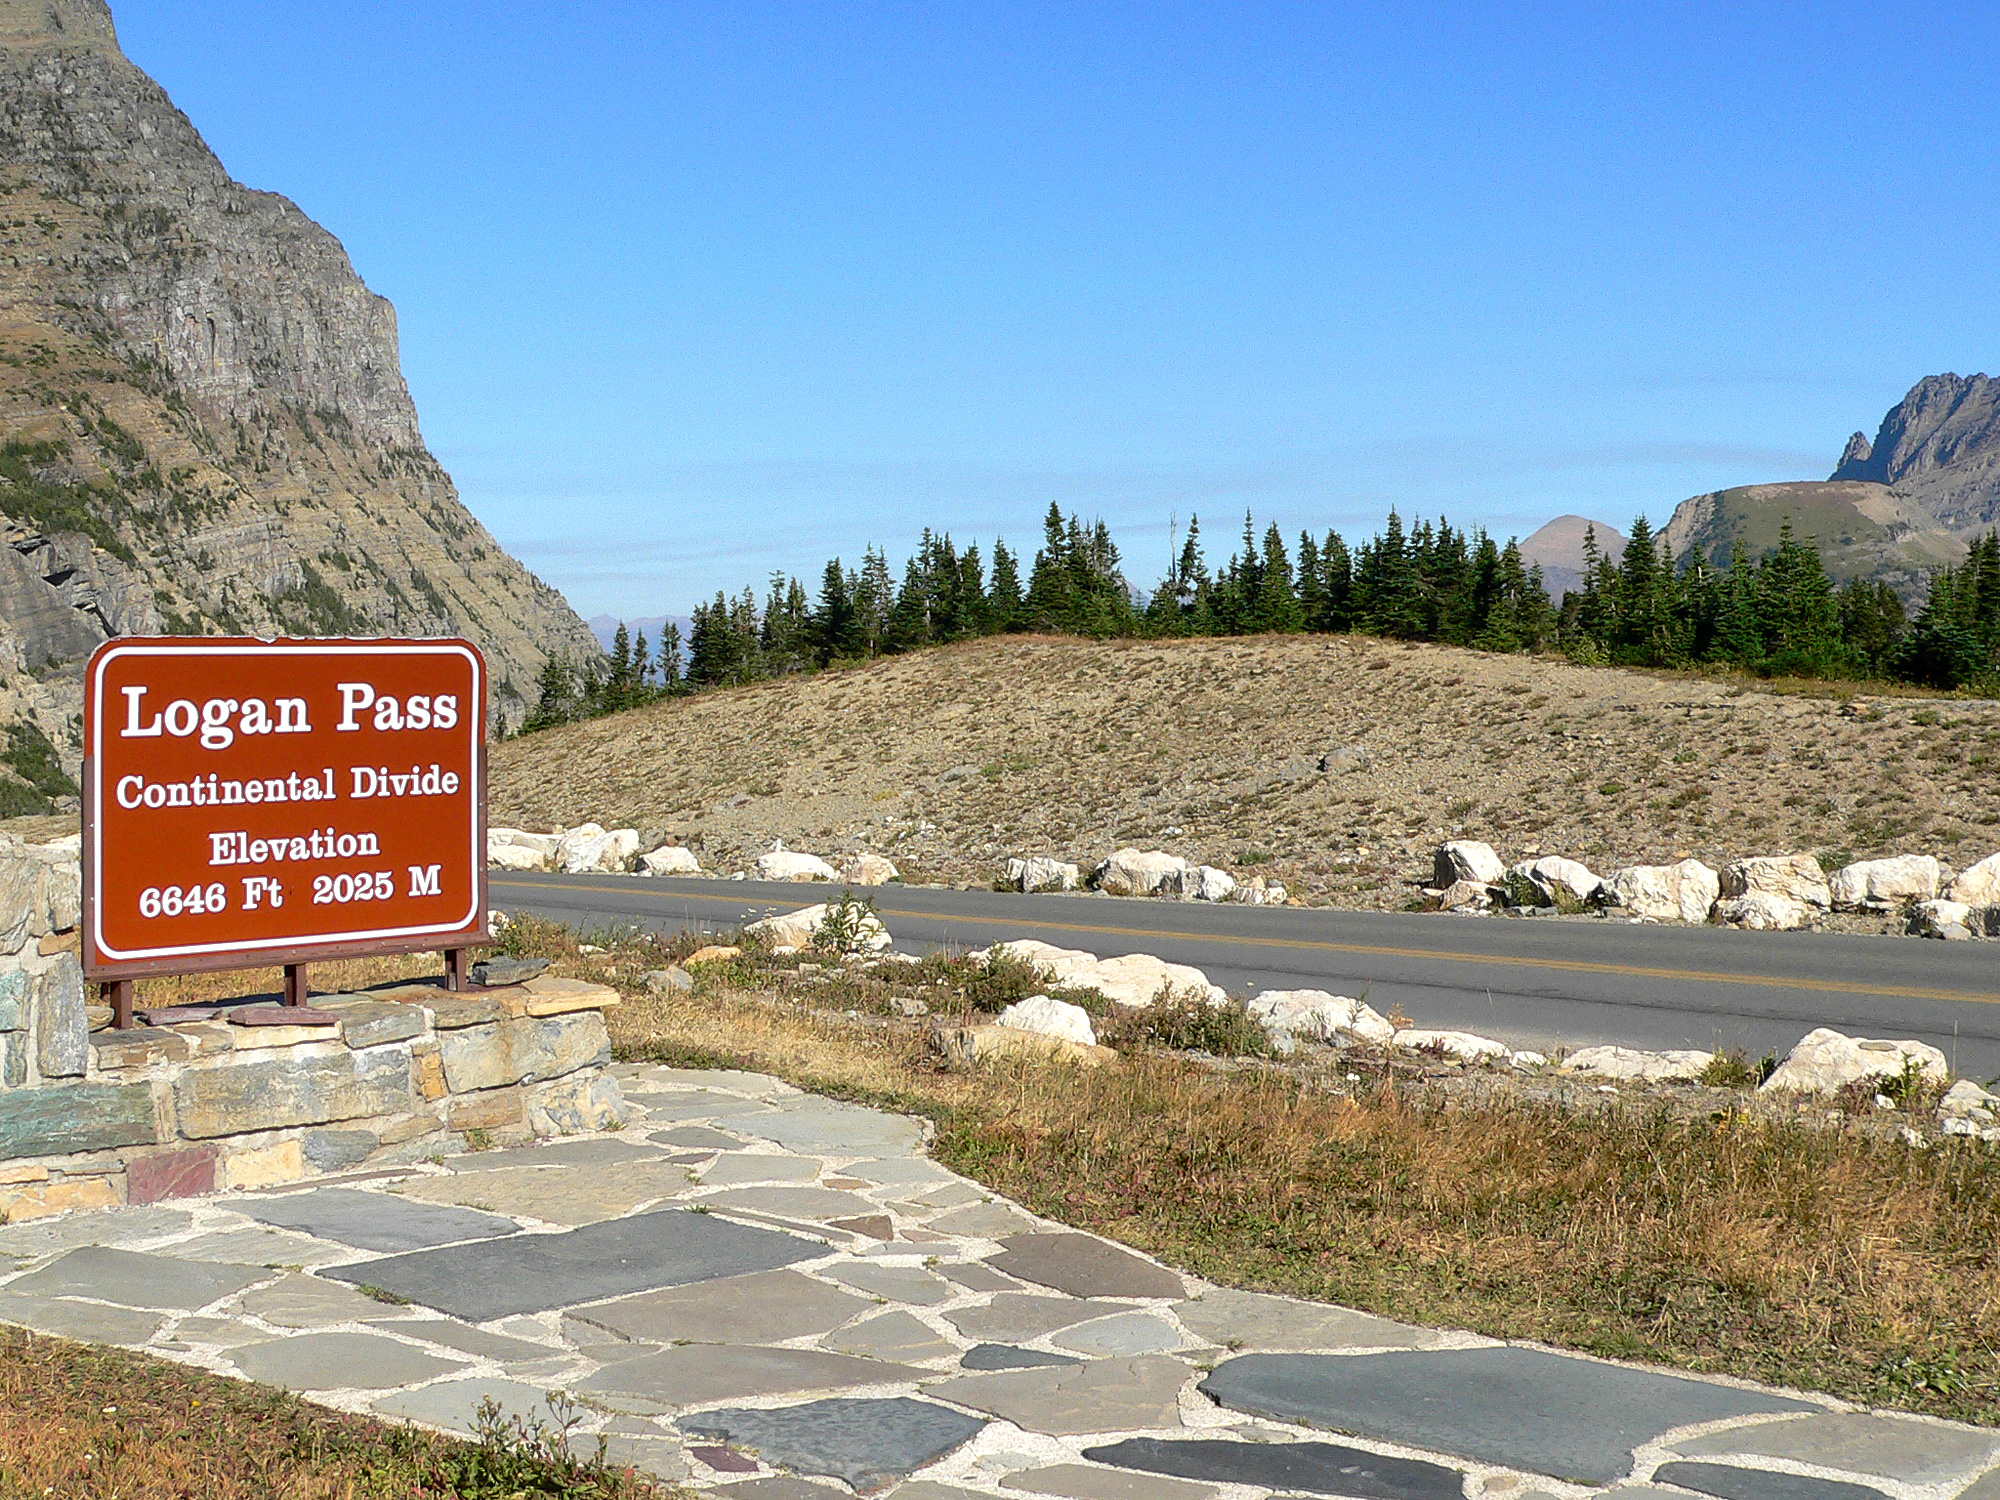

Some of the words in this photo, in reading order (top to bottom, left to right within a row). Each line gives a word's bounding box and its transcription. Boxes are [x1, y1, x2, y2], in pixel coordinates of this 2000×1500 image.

[121, 686, 312, 749] Logan
[336, 682, 458, 730] Pass
[116, 768, 336, 808] Continental
[350, 764, 459, 798] Divide
[208, 827, 380, 865] Elevation
[139, 883, 226, 917] 6646
[242, 876, 283, 909] Ft
[313, 871, 394, 904] 2025
[408, 864, 442, 896] M
